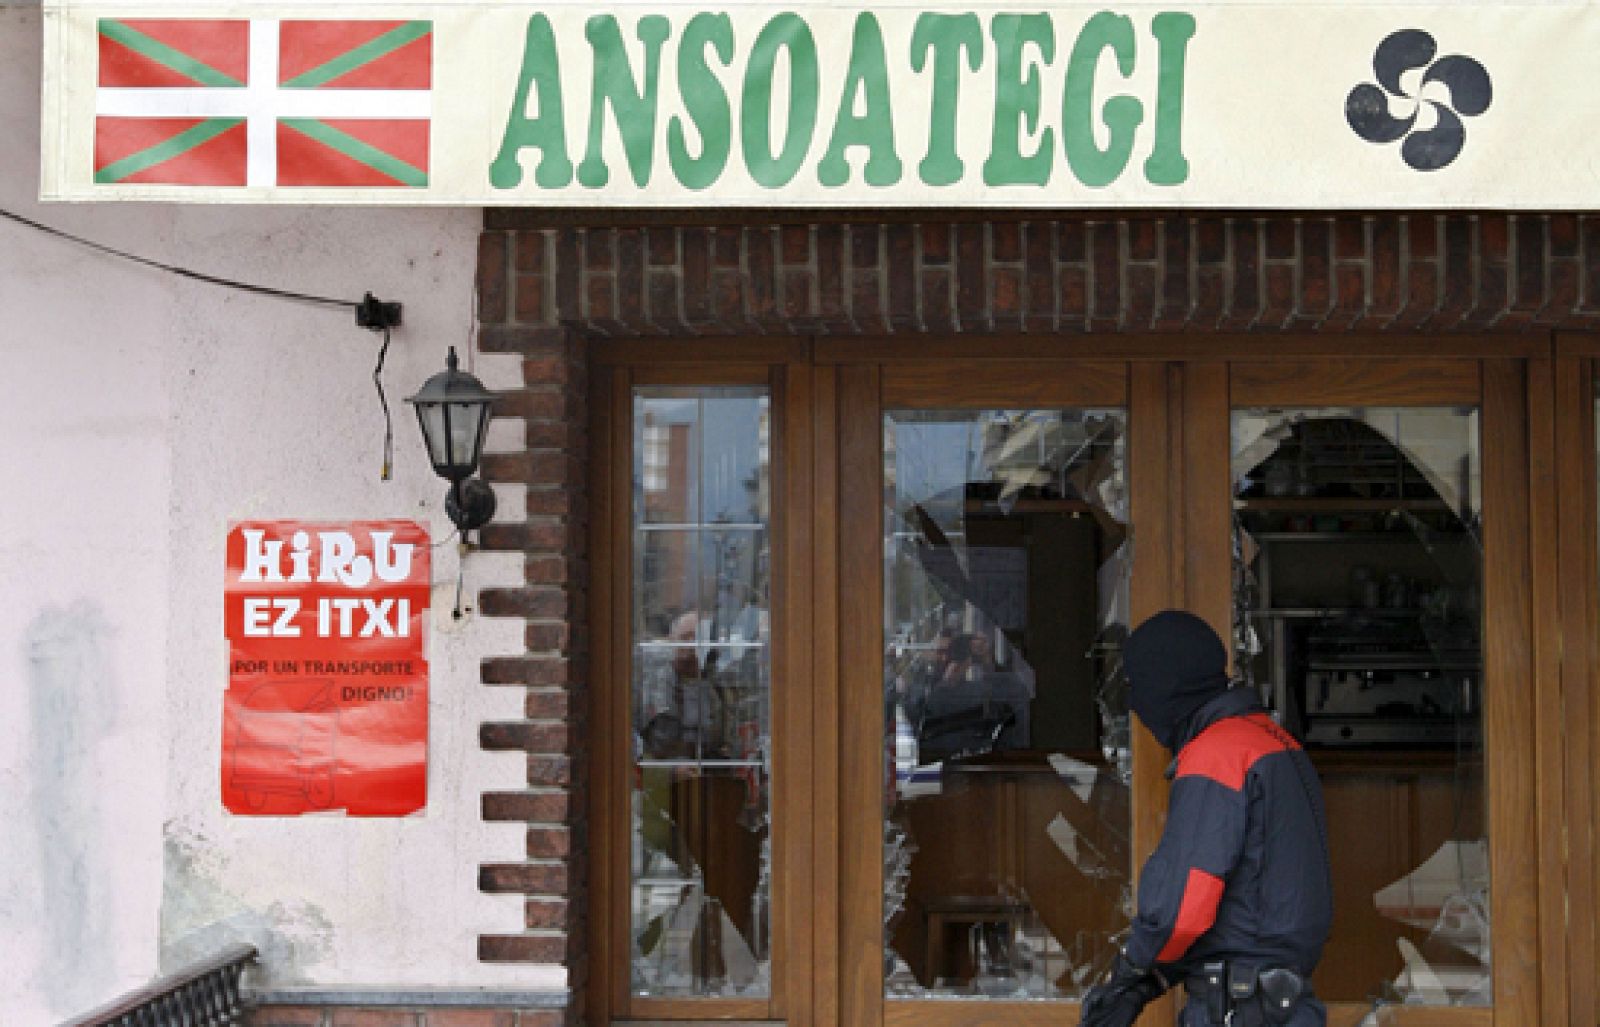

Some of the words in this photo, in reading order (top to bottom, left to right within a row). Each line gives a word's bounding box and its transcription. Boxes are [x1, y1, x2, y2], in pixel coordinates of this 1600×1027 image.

[489, 11, 1196, 190] ANSOATEGI
[243, 598, 301, 637] EZ
[318, 598, 411, 637] ITXI
[273, 660, 298, 674] UN
[303, 660, 414, 676] TRANSPORTE
